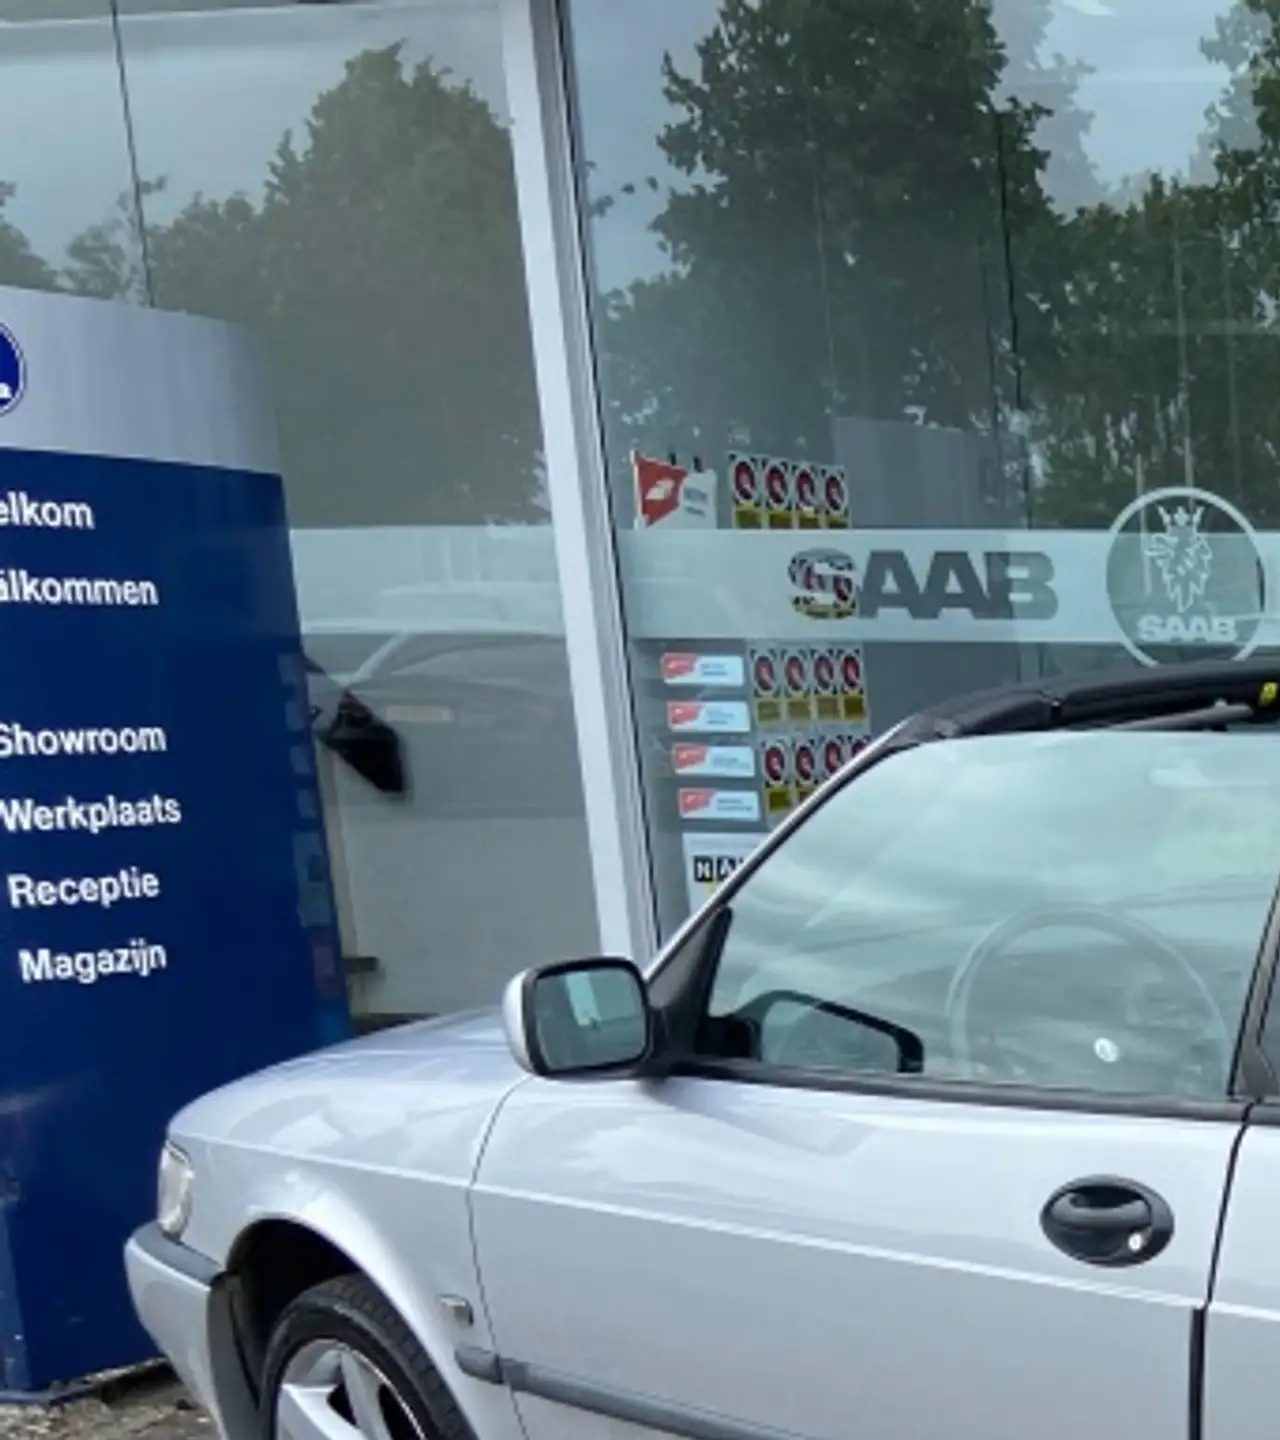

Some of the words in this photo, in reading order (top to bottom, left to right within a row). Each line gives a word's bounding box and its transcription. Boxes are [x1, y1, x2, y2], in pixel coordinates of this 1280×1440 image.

[788, 548, 1058, 620] SAAB
[1138, 614, 1238, 642] SAAB
[0, 722, 167, 759] Showroom
[0, 794, 182, 834] Werkplaats
[7, 866, 160, 908] Receptie
[19, 938, 167, 984] Magazijn
